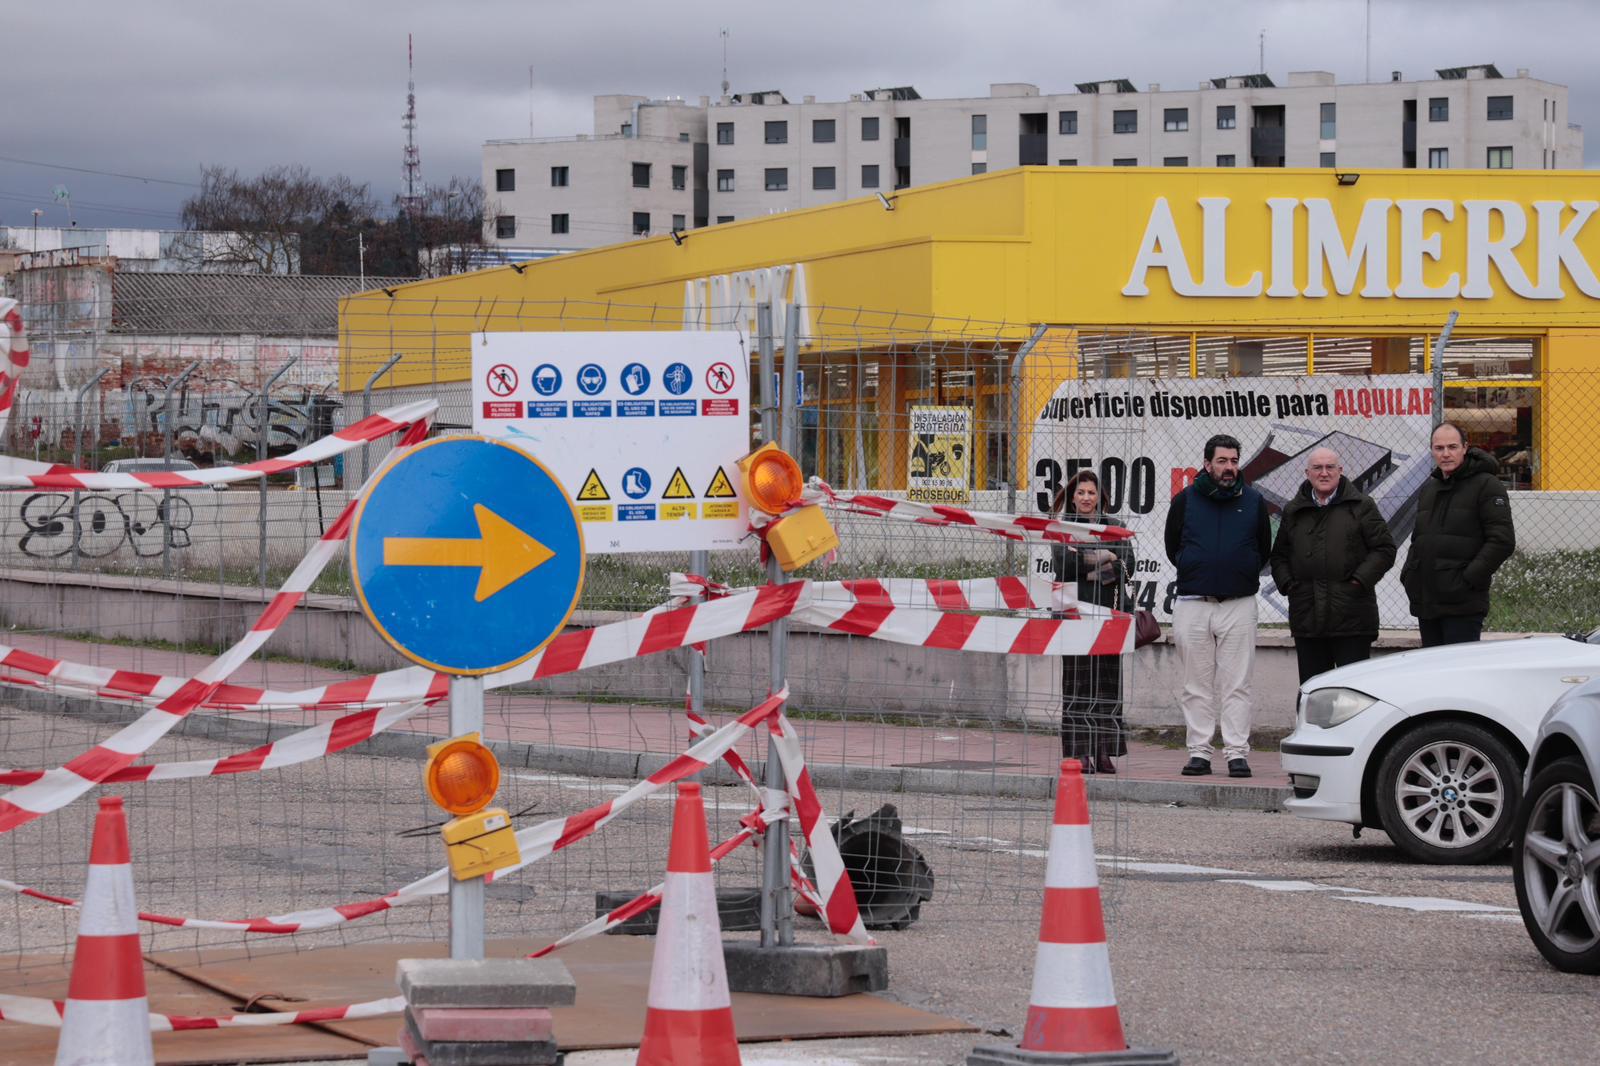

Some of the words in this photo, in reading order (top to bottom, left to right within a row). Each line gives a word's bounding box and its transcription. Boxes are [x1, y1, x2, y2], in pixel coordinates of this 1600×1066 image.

[1121, 196, 1600, 299] ALIMERK
[1150, 391, 1271, 420] disponible
[1276, 393, 1329, 419] para
[914, 422, 966, 432] PROTEGIDA
[909, 489, 965, 500] PROSEGUR
